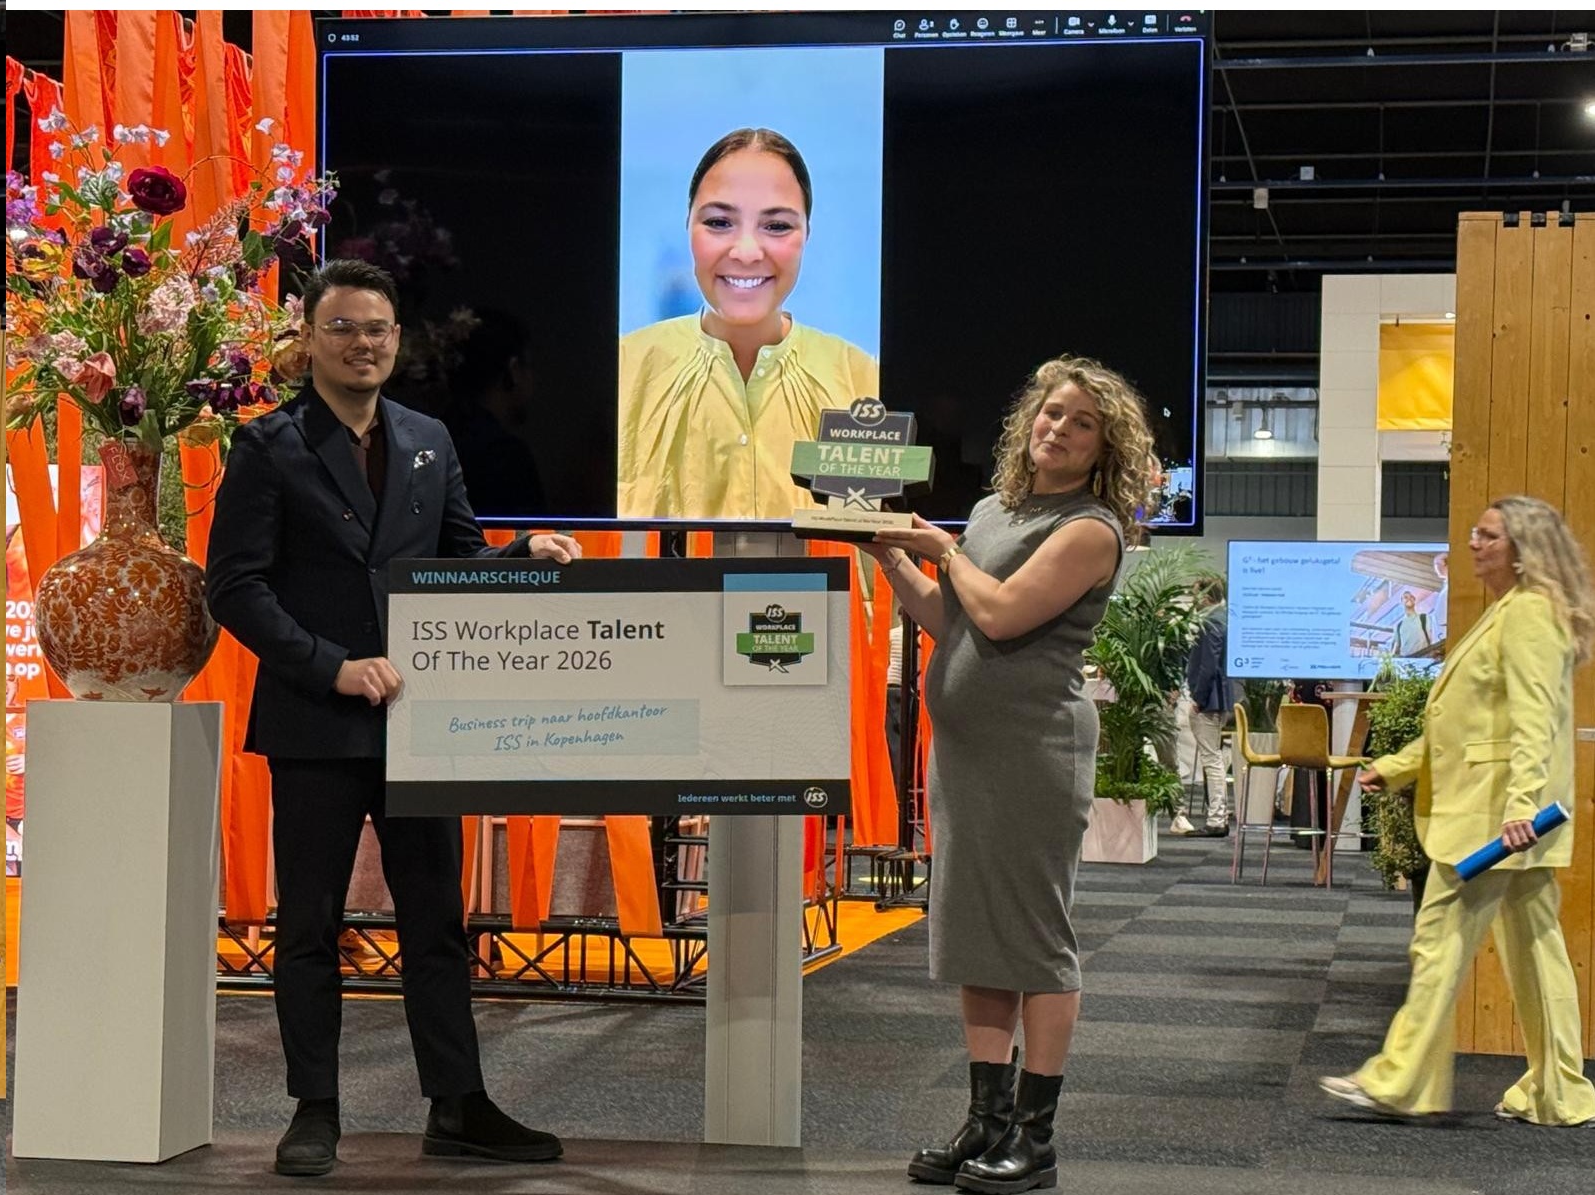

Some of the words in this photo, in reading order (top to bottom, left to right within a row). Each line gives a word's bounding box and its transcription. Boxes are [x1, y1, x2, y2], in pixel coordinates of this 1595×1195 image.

[830, 428, 901, 441] WORKPLACE
[818, 445, 905, 465] TALENT
[819, 463, 838, 474] OF
[840, 463, 865, 475] THE
[869, 465, 901, 477] YEAR
[412, 571, 561, 586] WINNAARSCHEQUE
[6, 600, 36, 619] 20
[412, 620, 447, 640] ISS
[455, 619, 580, 646] Workplace
[587, 619, 665, 640] Talent
[753, 634, 798, 645] TALENT
[412, 650, 441, 671] Of
[447, 650, 490, 671] The
[497, 651, 549, 671] Year
[557, 650, 612, 671] 2026
[15, 662, 40, 680] op
[449, 716, 506, 733] Business
[511, 713, 536, 731] trip
[541, 714, 573, 725] naar
[577, 703, 668, 722] hoofdkantoor
[494, 734, 522, 751] ISS
[526, 736, 539, 748] in
[544, 730, 624, 748] Kopenhagen
[678, 794, 719, 803] Iedereen
[721, 794, 748, 803] werkt
[750, 794, 775, 803] beter
[778, 794, 796, 803] met
